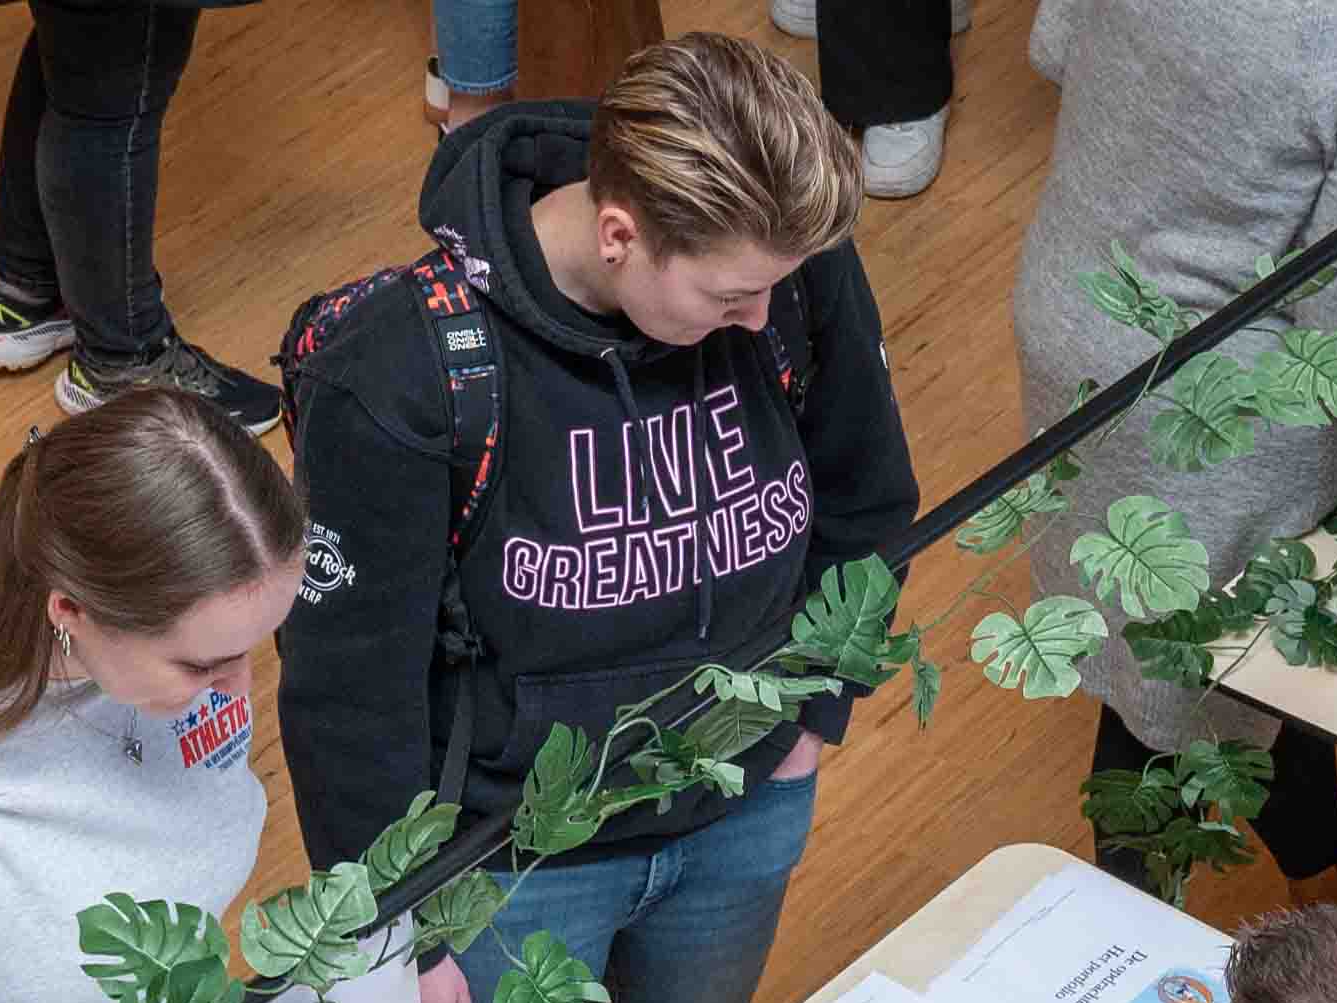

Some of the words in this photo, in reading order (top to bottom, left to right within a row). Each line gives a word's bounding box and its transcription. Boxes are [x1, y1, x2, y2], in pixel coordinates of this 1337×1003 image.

[570, 385, 755, 533] LIVE
[502, 461, 809, 609] GREATNESS
[321, 552, 356, 586] Rock
[1126, 949, 1149, 966] De
[1054, 960, 1101, 1000] portfolio
